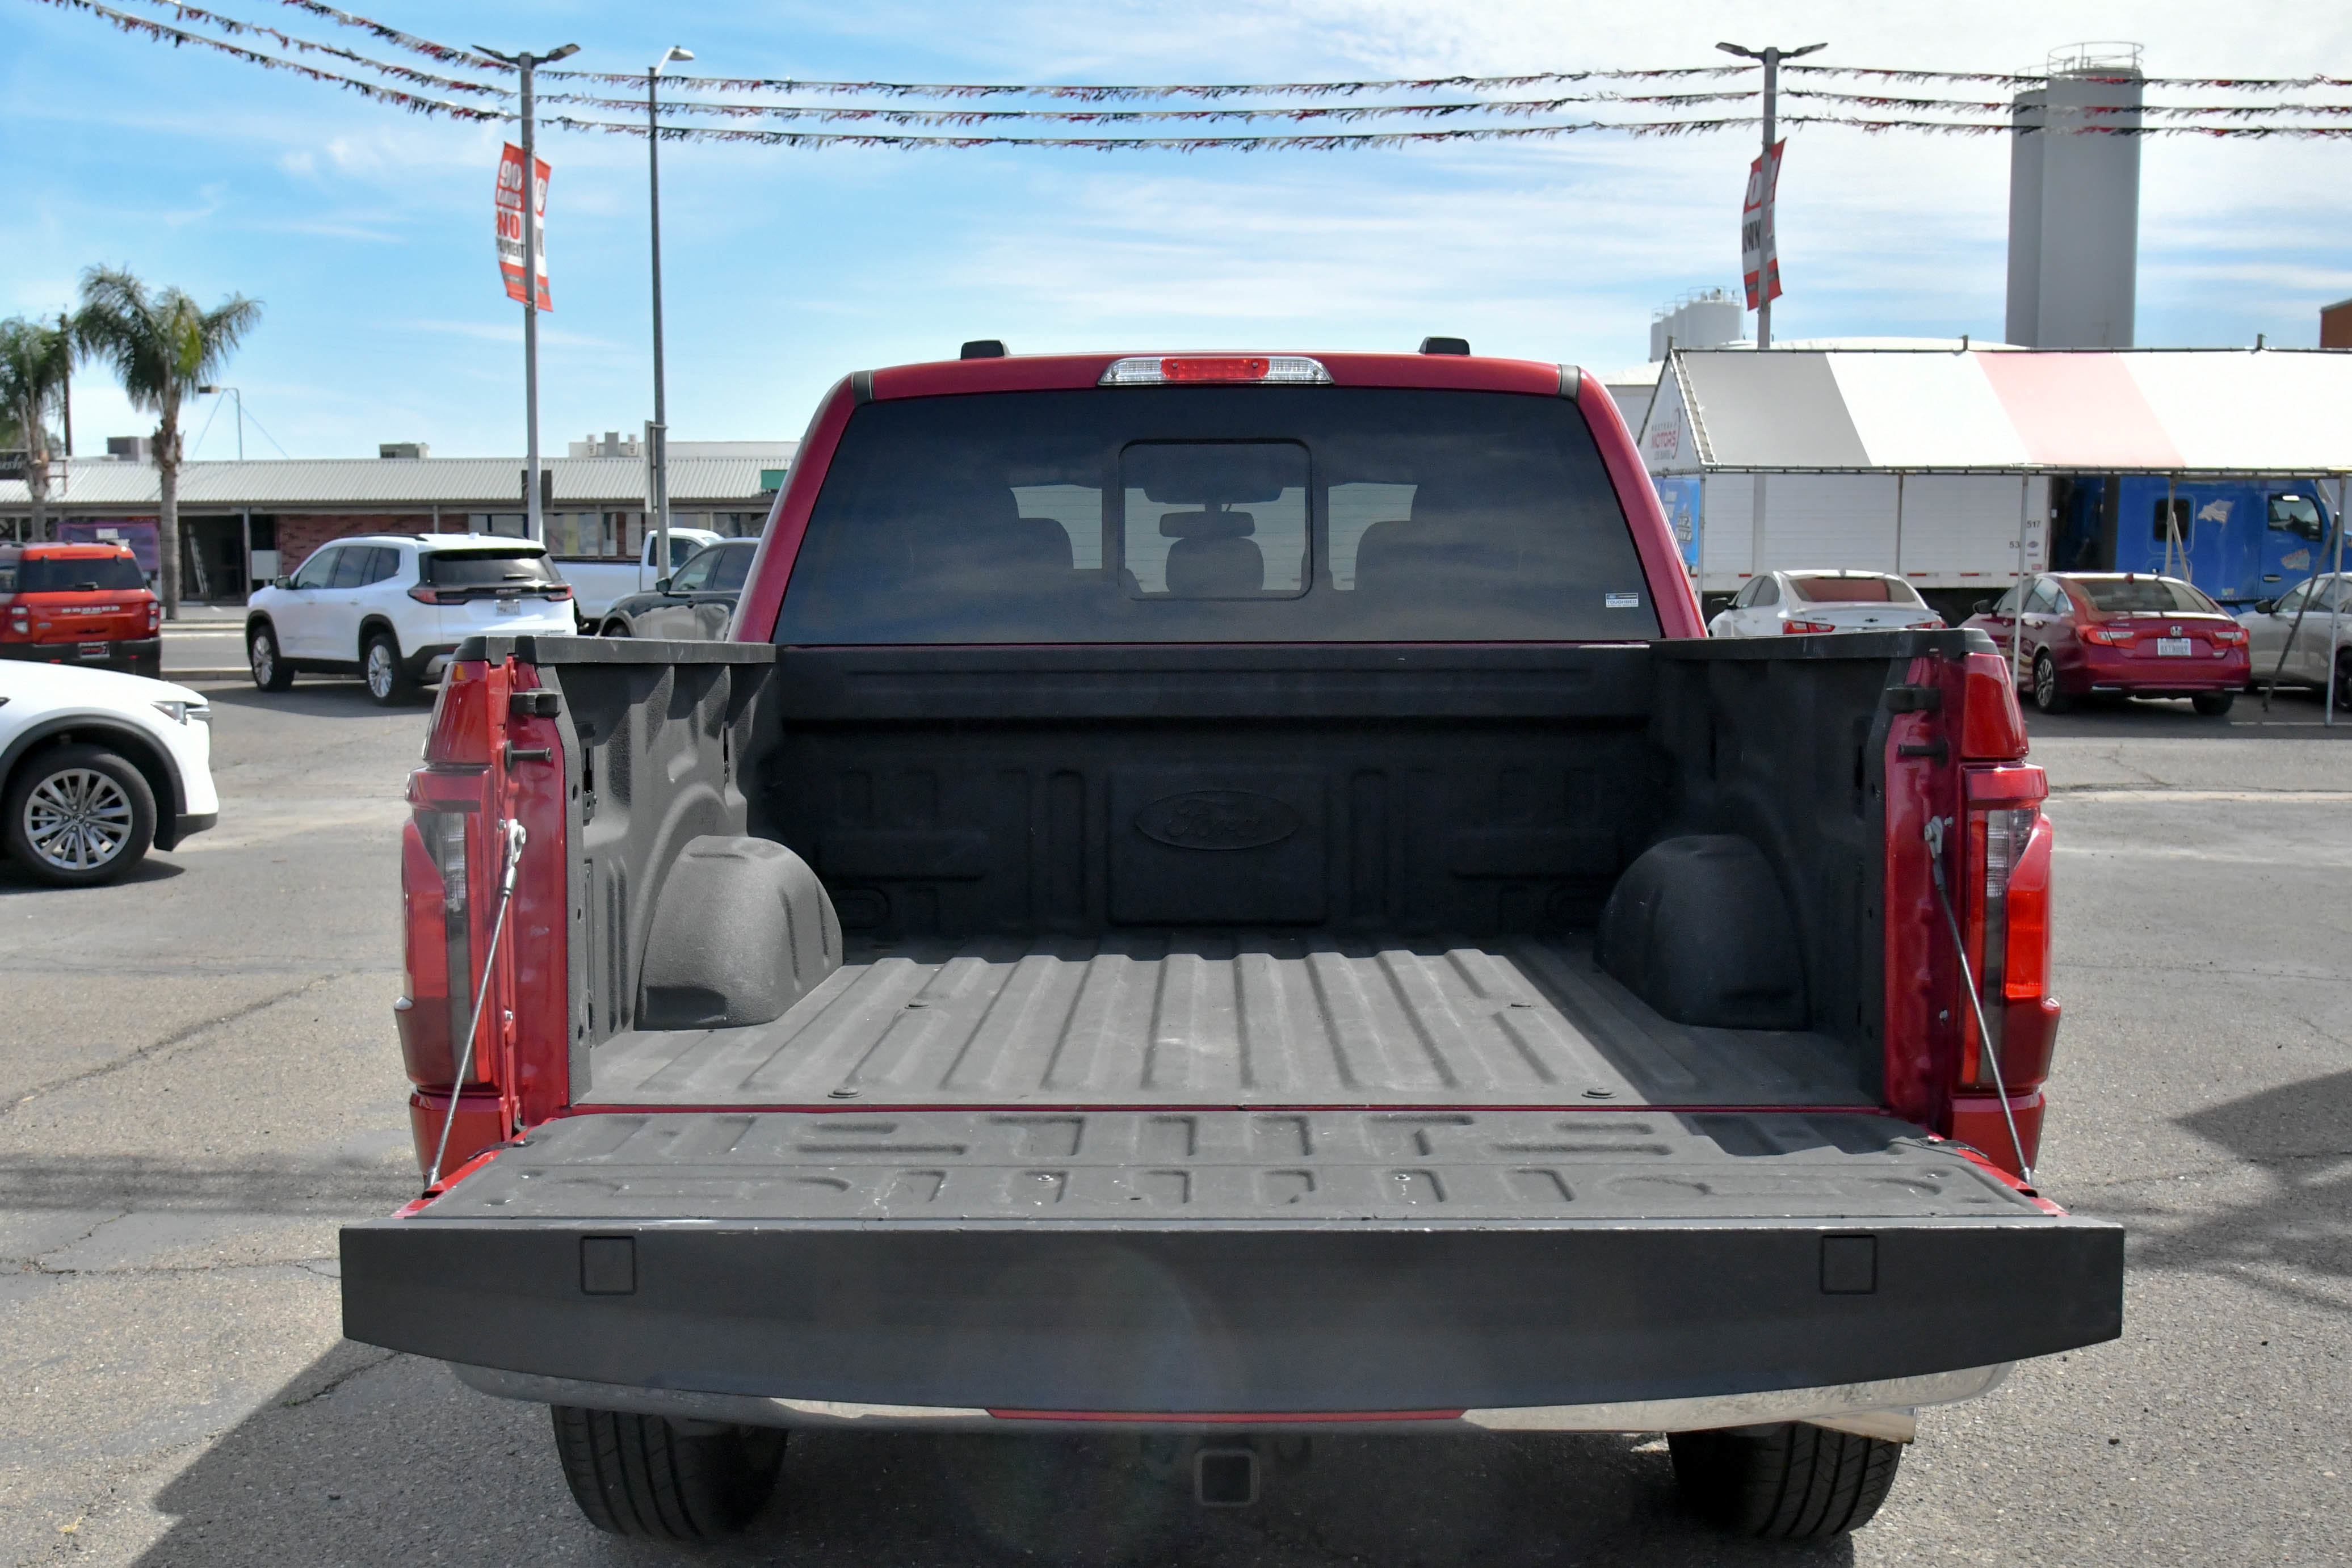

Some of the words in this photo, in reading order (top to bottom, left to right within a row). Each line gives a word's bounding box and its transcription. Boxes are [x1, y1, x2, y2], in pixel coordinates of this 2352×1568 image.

[499, 160, 522, 191] 90
[497, 211, 520, 239] NO
[1651, 430, 1676, 449] MOTORS
[2027, 520, 2041, 528] 517
